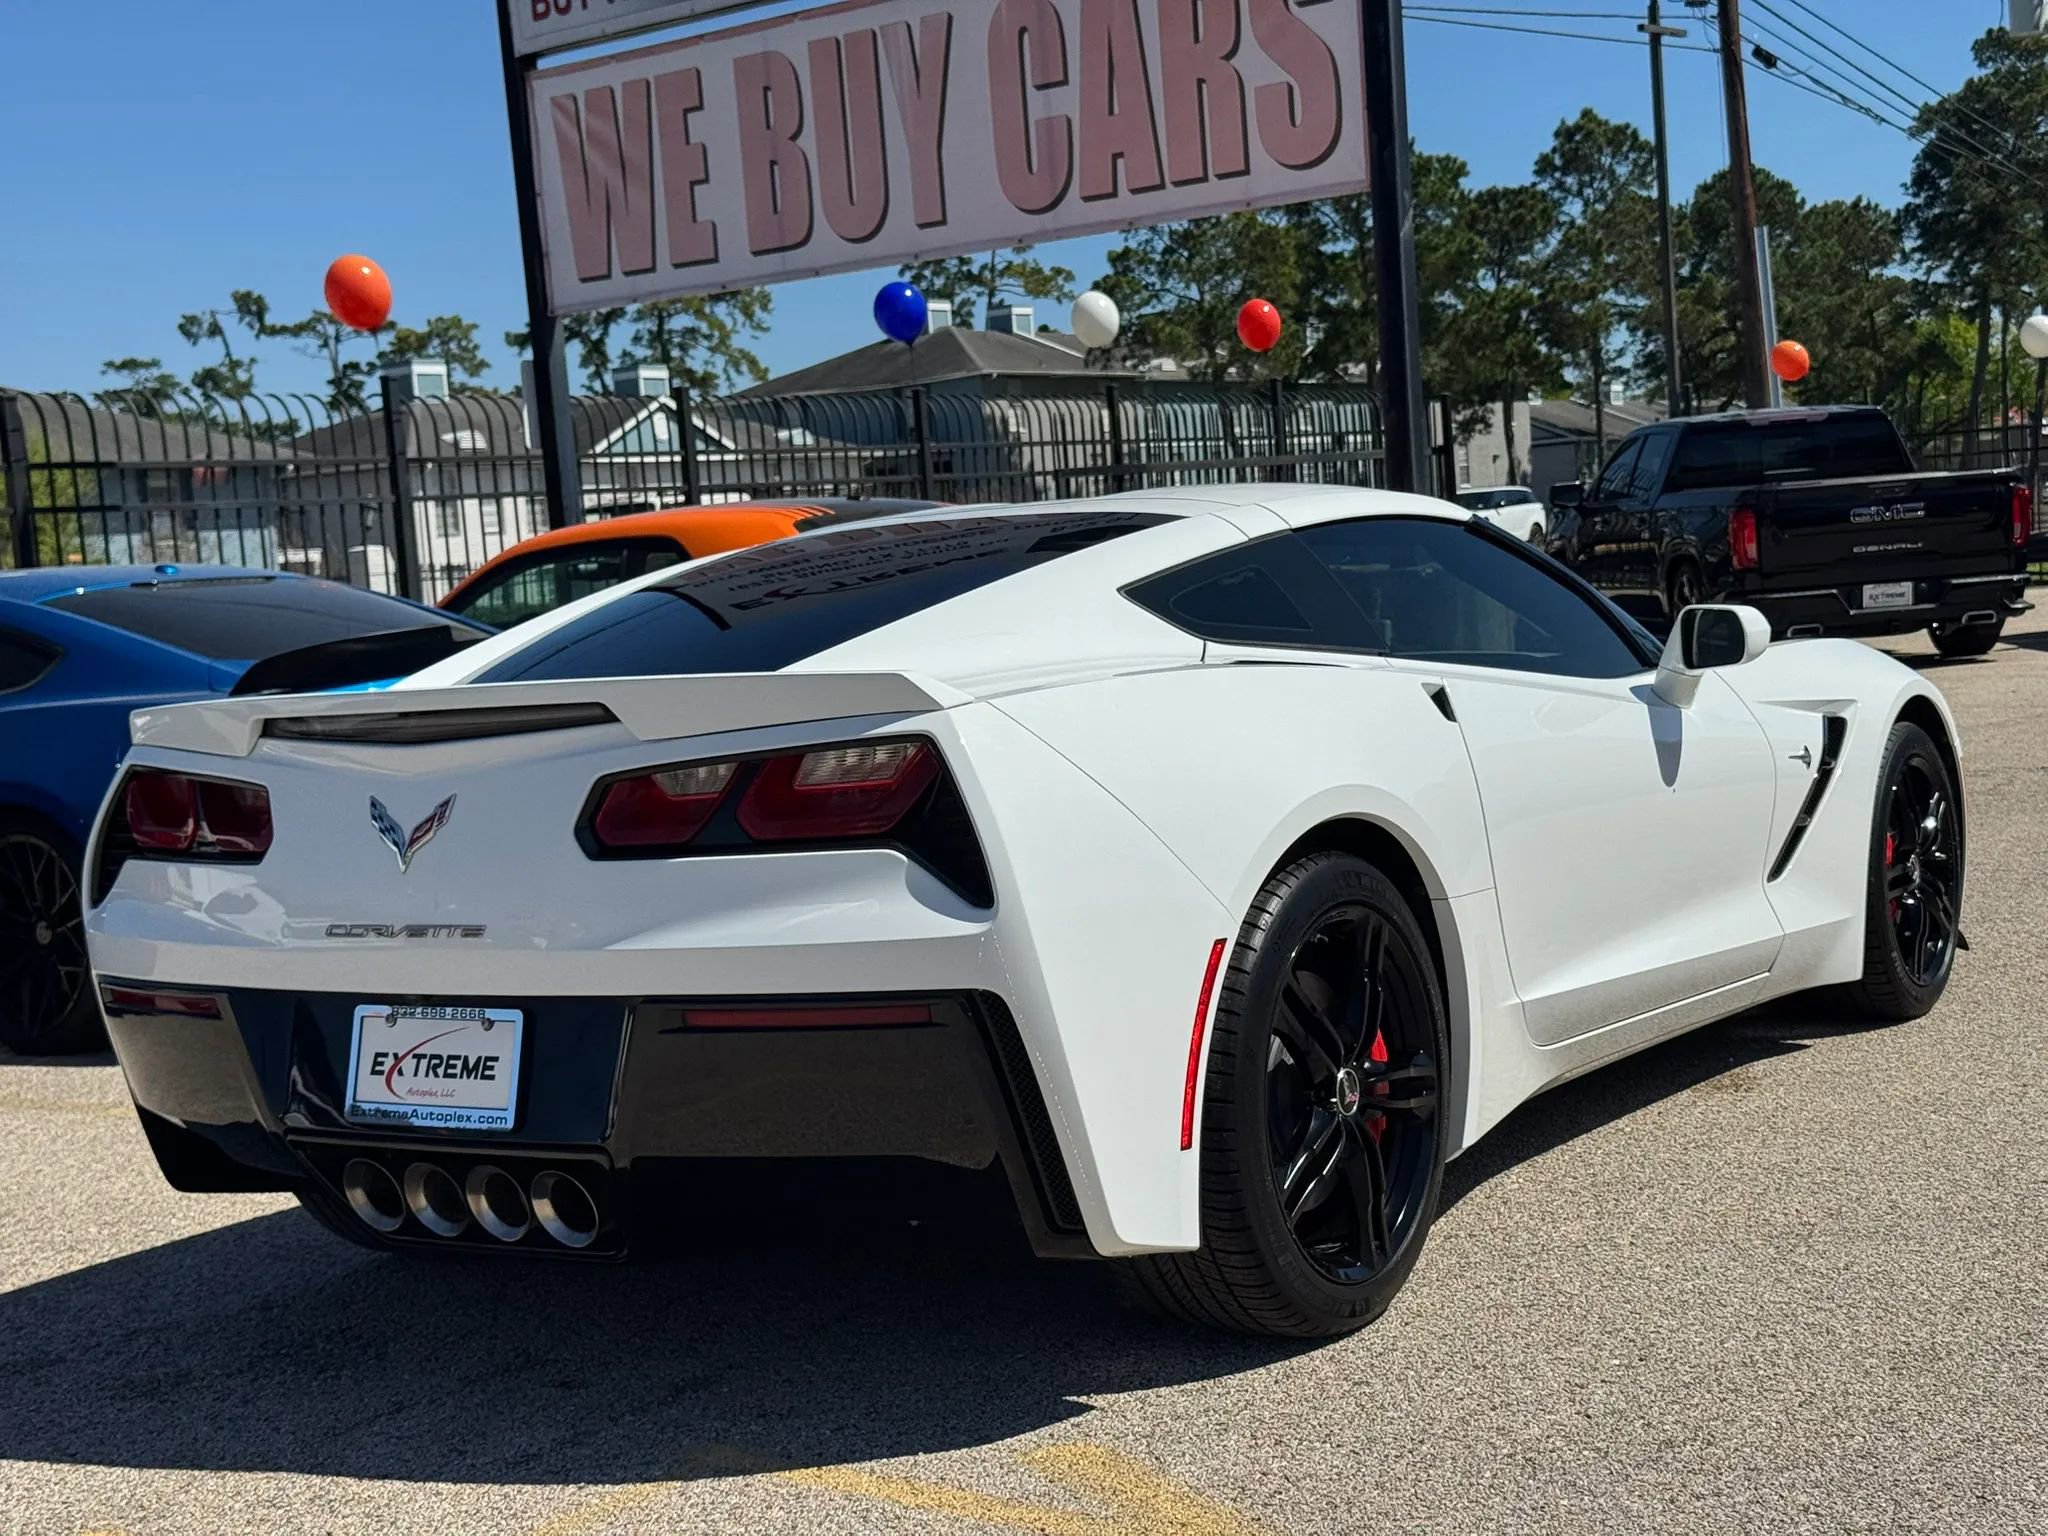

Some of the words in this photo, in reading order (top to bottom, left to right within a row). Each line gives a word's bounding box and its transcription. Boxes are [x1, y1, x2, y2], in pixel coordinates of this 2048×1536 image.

[551, 67, 719, 283] WE
[733, 11, 954, 257] BUY
[987, 0, 1343, 215] CARS
[1850, 502, 1925, 523] GMC
[325, 924, 487, 938] CORVETTE
[391, 1006, 486, 1019] 832-698-2668
[370, 1052, 499, 1081] EXTREME
[441, 1088, 456, 1098] LLC
[350, 1104, 508, 1126] ExtremeAutoplex.com
